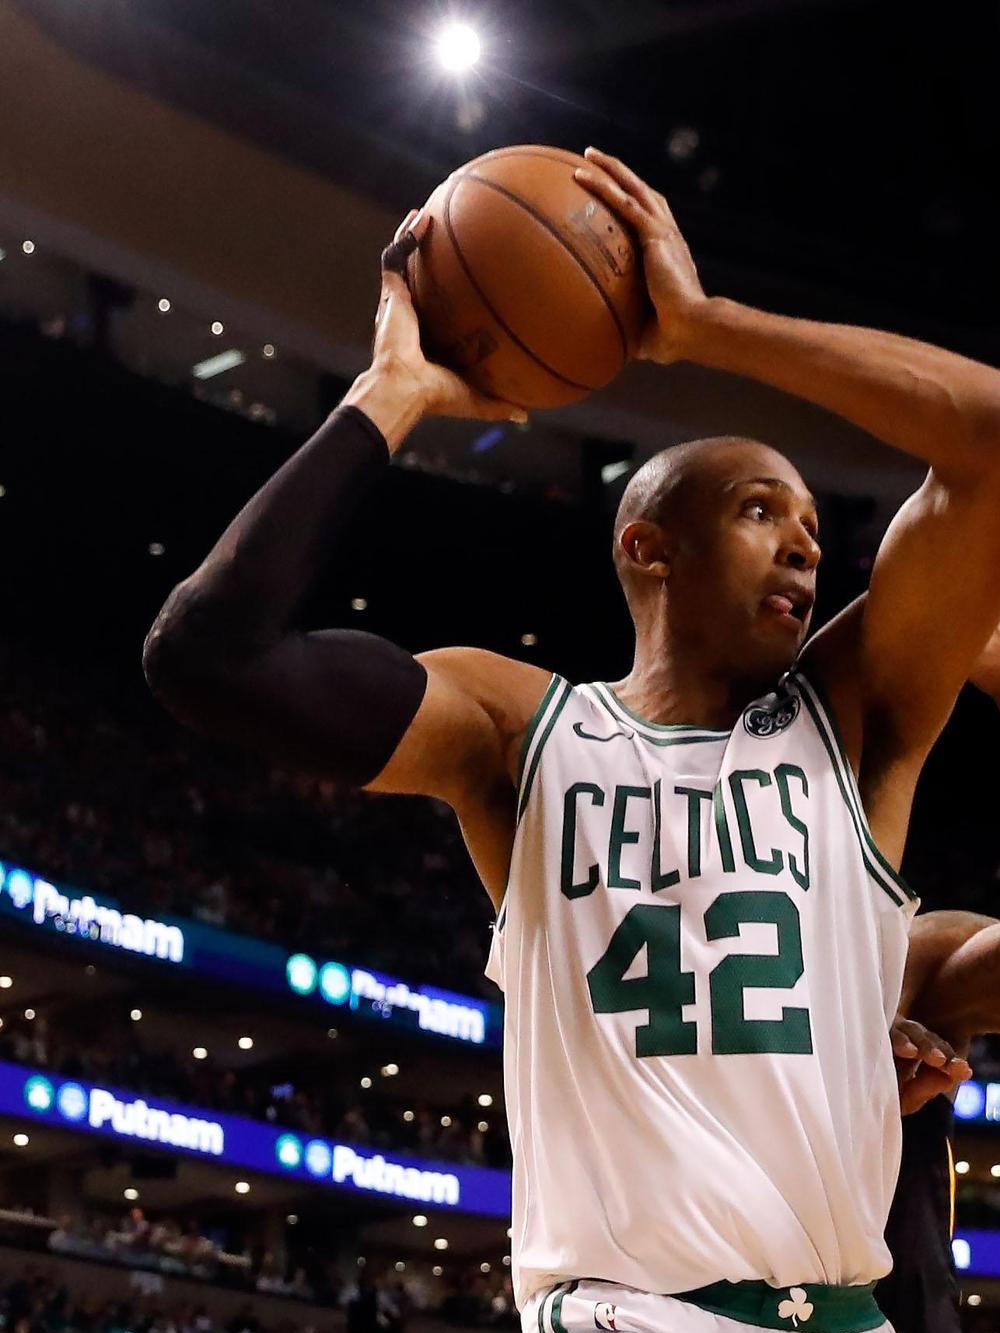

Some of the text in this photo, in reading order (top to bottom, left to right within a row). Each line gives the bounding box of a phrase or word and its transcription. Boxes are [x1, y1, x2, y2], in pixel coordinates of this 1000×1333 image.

[561, 763, 810, 900] CELTICS
[586, 891, 814, 1058] 42
[88, 1088, 224, 1156] Putnam
[332, 1145, 460, 1205] Putnam
